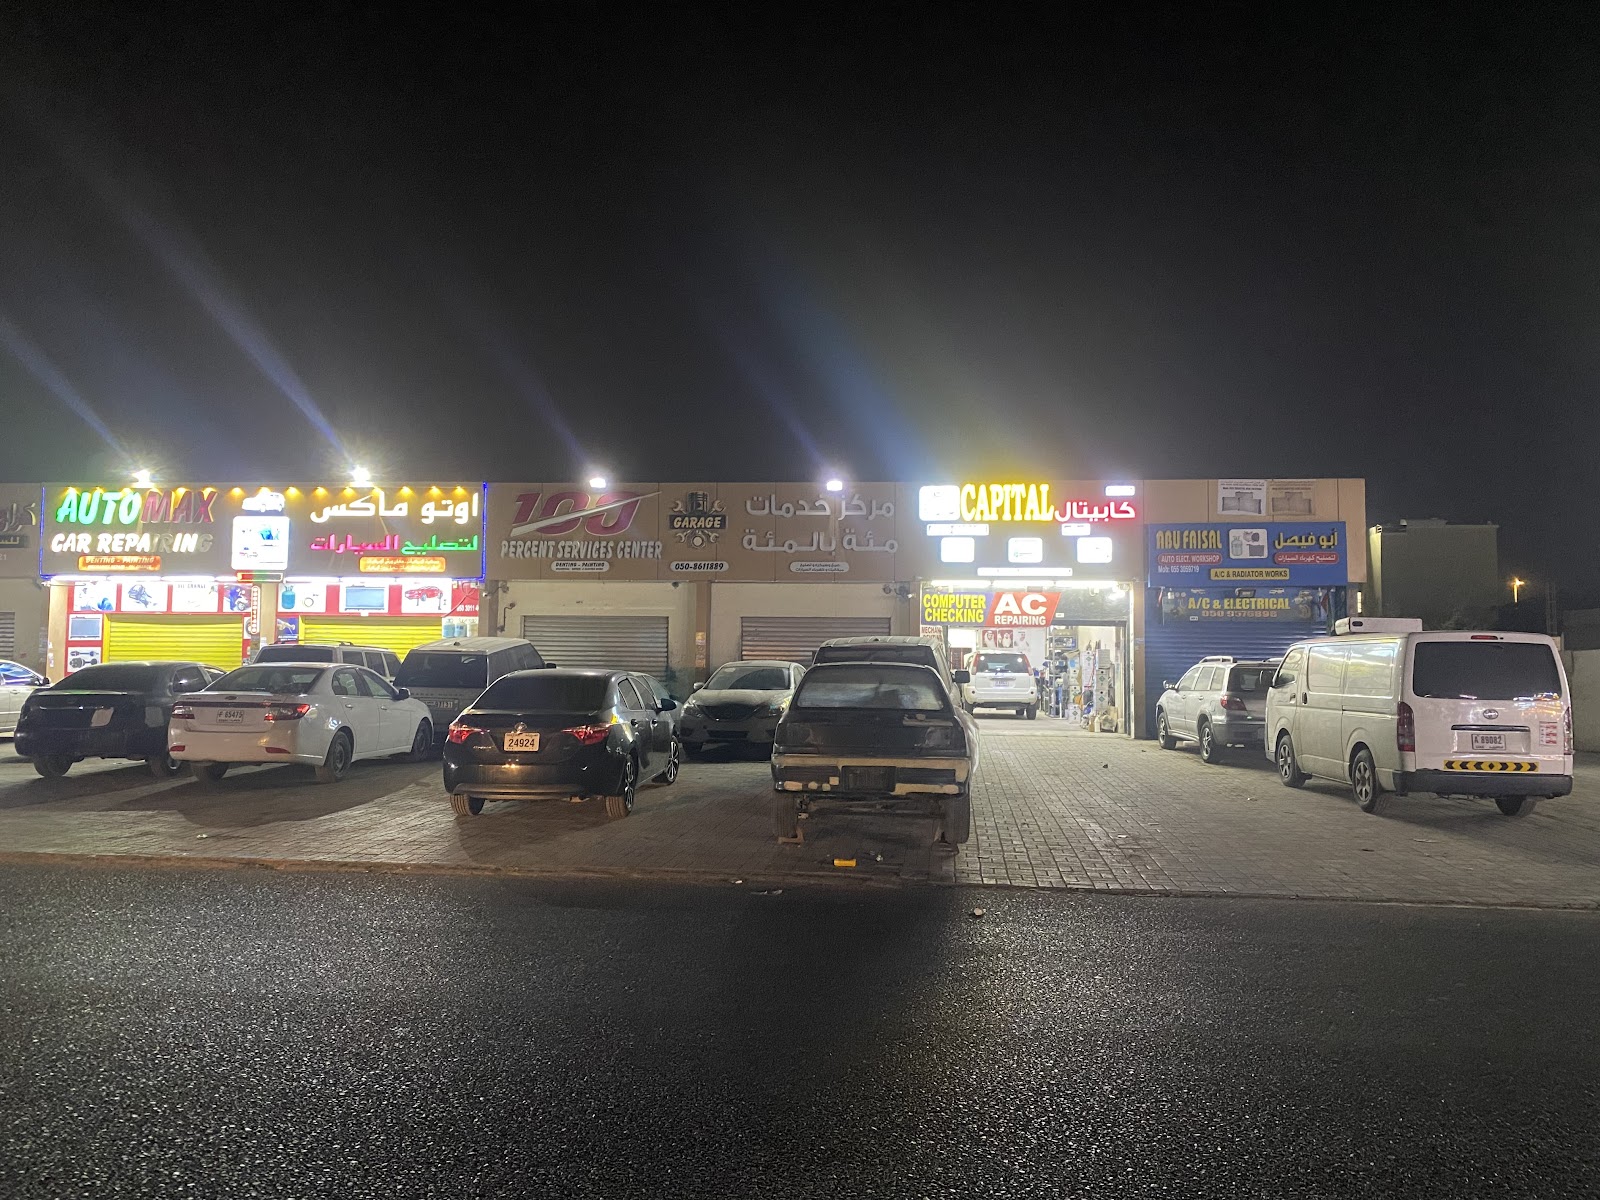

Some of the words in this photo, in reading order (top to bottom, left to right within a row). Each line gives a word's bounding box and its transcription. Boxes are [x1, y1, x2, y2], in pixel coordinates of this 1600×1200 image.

[56, 490, 142, 525] AUTO
[141, 490, 218, 523] MAX
[310, 487, 408, 523] ماكس
[421, 493, 478, 524] اوتو
[745, 494, 832, 518] خدمات
[837, 494, 894, 521] مركز
[960, 483, 1055, 522] CAPITAL
[1054, 501, 1136, 522] كابيتال
[512, 491, 642, 537] 100
[673, 517, 722, 528] GARAGE
[51, 533, 91, 553] CAR
[97, 533, 213, 553] REPAIRING
[310, 534, 399, 554] السيارات
[401, 534, 479, 555] لتصليح
[742, 529, 837, 556] بالمئة
[842, 528, 899, 553] مئة
[1156, 530, 1180, 549] ABU
[1183, 530, 1222, 549] FAISAL
[1275, 532, 1315, 549] فيصل
[1319, 527, 1338, 549] أبو
[501, 541, 556, 559] PERCENT
[557, 541, 613, 559] SERVICES
[617, 541, 663, 559] CENTER
[1191, 554, 1220, 562] WORKSHOP
[923, 594, 986, 608] COMPUTER
[994, 593, 1047, 615] AC
[1188, 598, 1210, 609] A/C
[1213, 600, 1221, 609] &
[1224, 598, 1290, 609] ELECTRICAL
[925, 608, 984, 622] CHECKING
[995, 616, 1046, 624] REPAIRING
[508, 738, 535, 747] 24924
